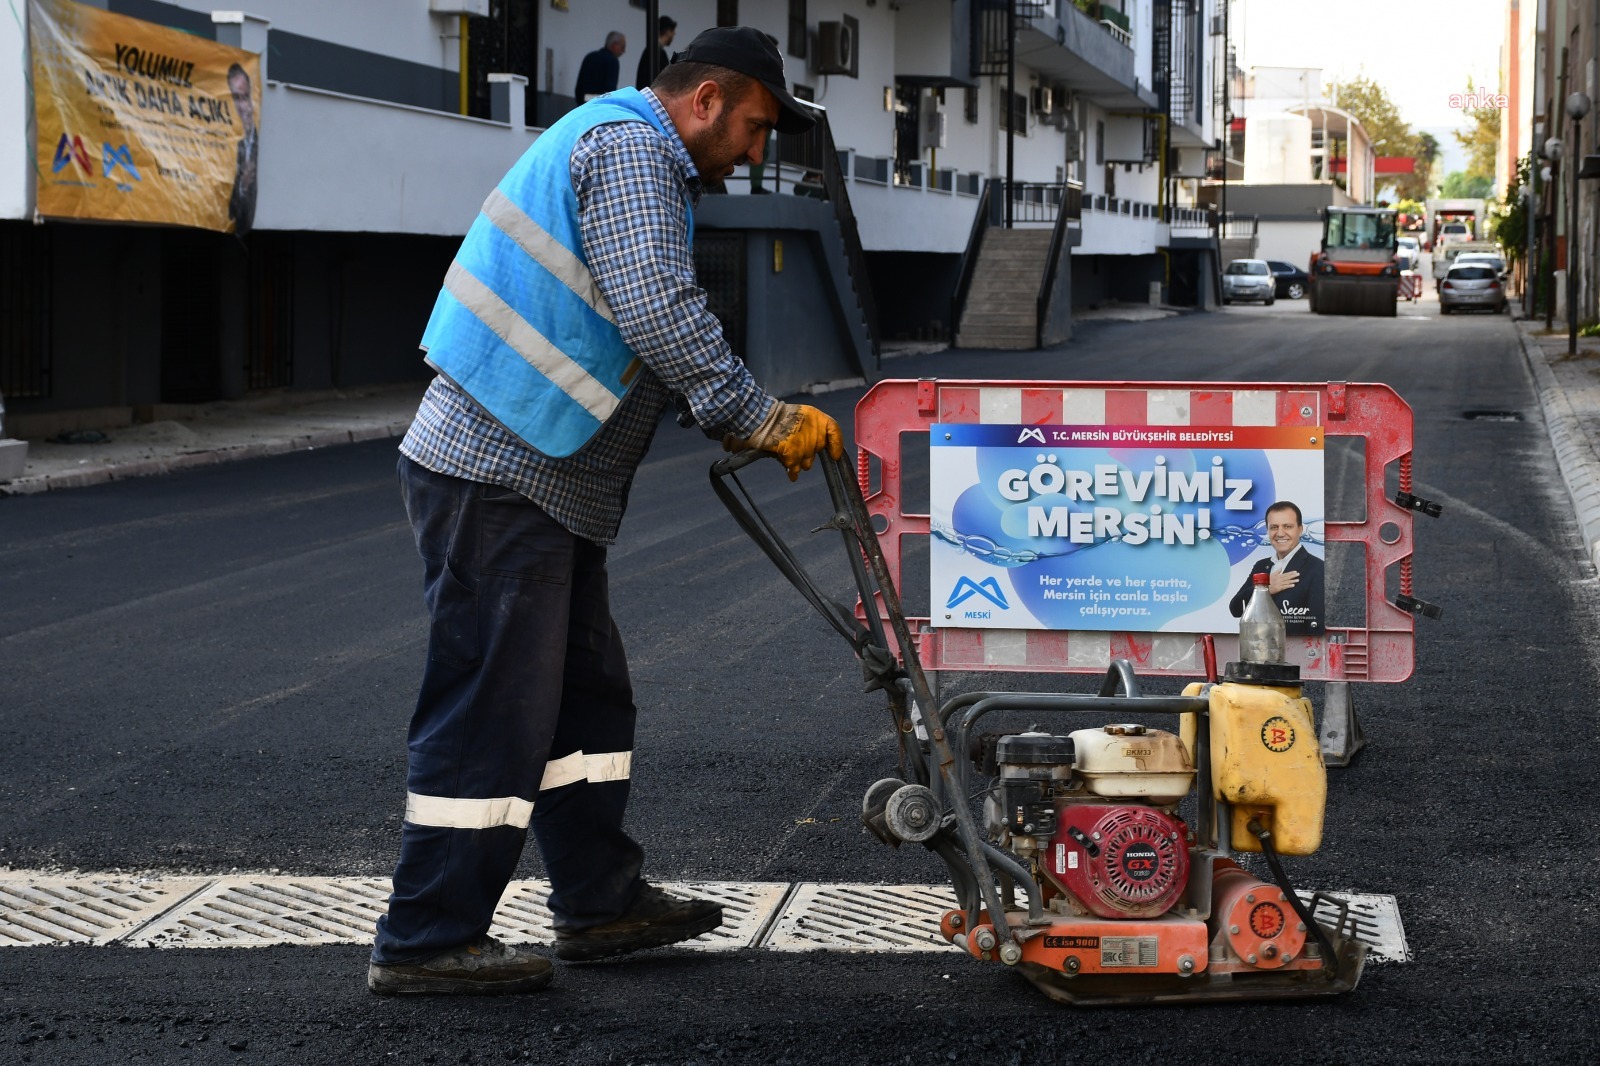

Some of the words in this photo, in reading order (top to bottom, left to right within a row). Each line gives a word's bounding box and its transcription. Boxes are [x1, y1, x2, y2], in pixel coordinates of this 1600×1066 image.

[114, 43, 195, 88] YOLUMUZ
[134, 81, 185, 117] DAHA
[188, 94, 233, 126] AÇIK!
[1052, 431, 1070, 440] T.C.
[1071, 429, 1110, 441] MERSİN
[1112, 429, 1177, 443] BÜYÜKŞEHİR
[1179, 430, 1234, 442] BELEDİYESİ
[997, 453, 1253, 511] GÖREVİMİZ
[1027, 504, 1211, 546] MERSİN!
[1039, 575, 1063, 586] Her
[1066, 575, 1103, 588] yerde
[1106, 577, 1121, 587] ve
[1125, 575, 1146, 587] her
[1150, 577, 1192, 590] şartta,
[1043, 589, 1086, 600] Mersin
[1089, 589, 1111, 603] için
[1115, 590, 1149, 601] canla
[1152, 591, 1188, 604] başla
[964, 609, 991, 619] MESKİ
[1079, 603, 1151, 618] çalışıyoruz.
[1127, 859, 1155, 870] GX
[1076, 938, 1097, 946] 9001
